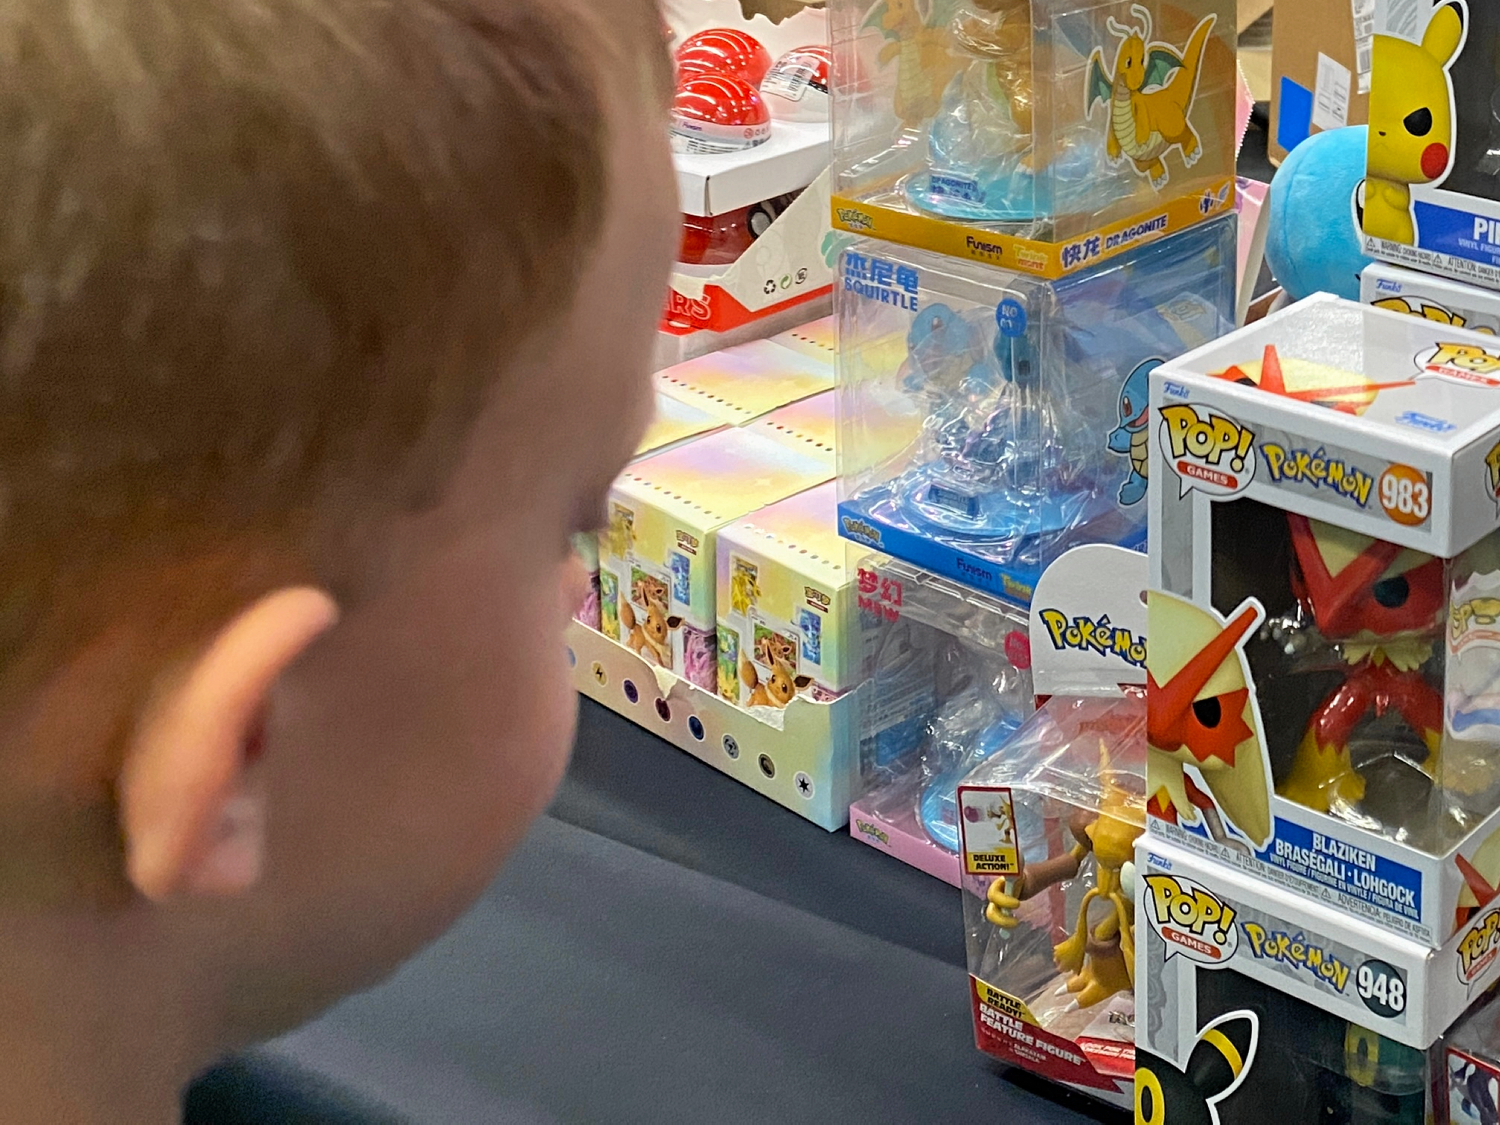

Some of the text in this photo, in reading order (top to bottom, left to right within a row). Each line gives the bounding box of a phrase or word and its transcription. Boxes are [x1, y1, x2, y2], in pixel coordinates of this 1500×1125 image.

[837, 209, 875, 230] Pokémon
[1105, 215, 1167, 250] DRAGONITE
[1063, 236, 1101, 268] 快龙
[844, 277, 918, 312] SQUIRTLE
[1159, 404, 1256, 473] POP!
[1186, 464, 1229, 485] GAMES
[1259, 444, 1375, 508] Pokémon
[1382, 480, 1429, 519] 983
[1039, 607, 1147, 667] Pokémo
[973, 854, 1006, 864] DELUXE
[1313, 832, 1375, 872] BLAZIKEN
[1276, 838, 1415, 908] BRASÉGALI LOHGOCK
[1142, 875, 1236, 947] POP!
[1171, 932, 1213, 955] GAMES
[1242, 920, 1352, 994] Pokémon
[986, 988, 1021, 1010] BATTLE
[1358, 969, 1405, 1009] 948
[979, 1002, 1023, 1031] BATTLE
[980, 1013, 1034, 1046] FEATURE
[1035, 1038, 1082, 1067] FIGURE
